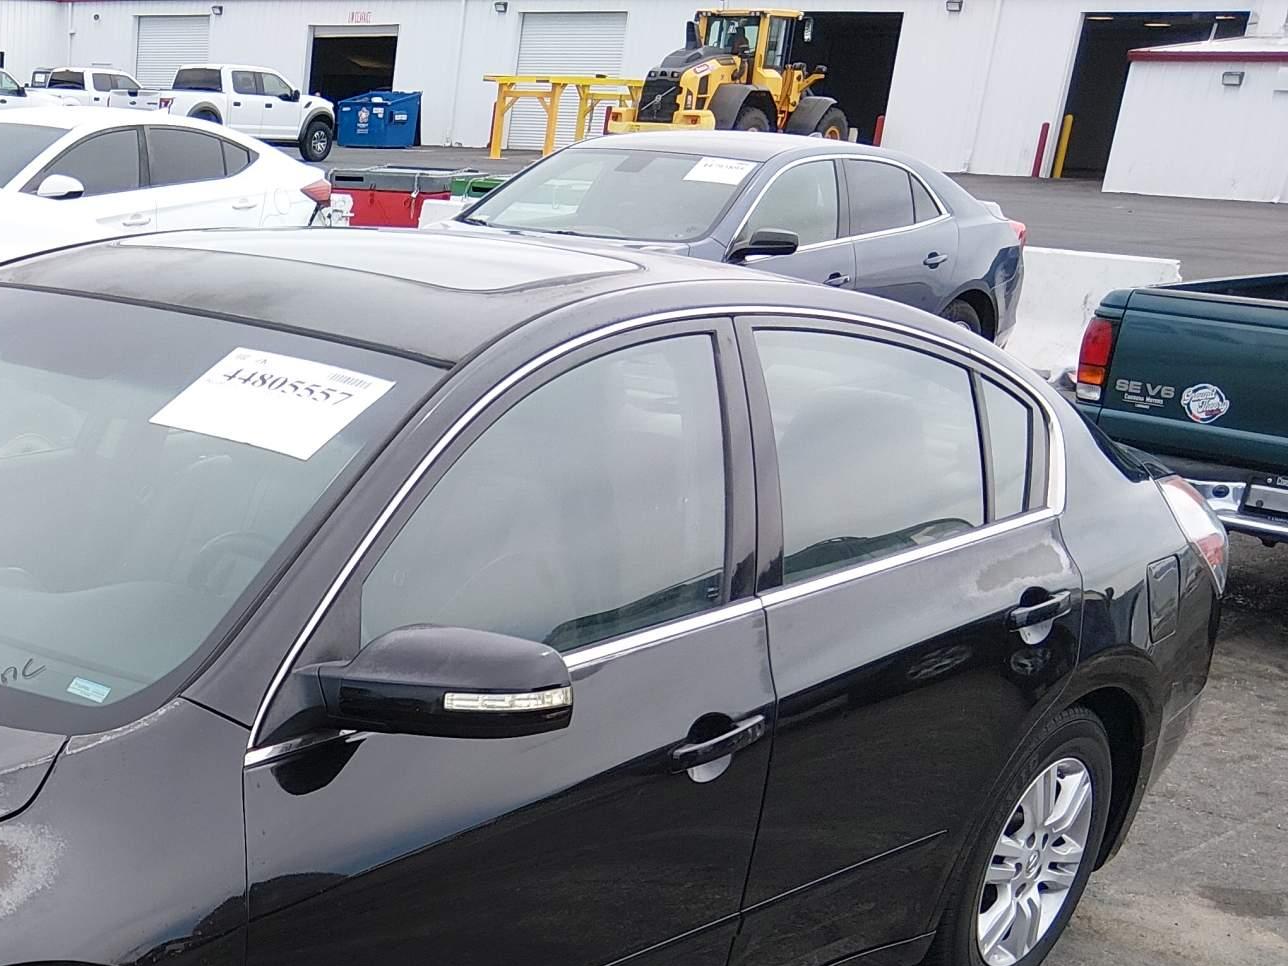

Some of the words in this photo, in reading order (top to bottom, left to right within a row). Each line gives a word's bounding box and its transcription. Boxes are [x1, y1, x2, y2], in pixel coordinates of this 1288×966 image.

[223, 368, 354, 406] 44805557
[1115, 379, 1143, 394] SE
[1145, 383, 1175, 399] V6
